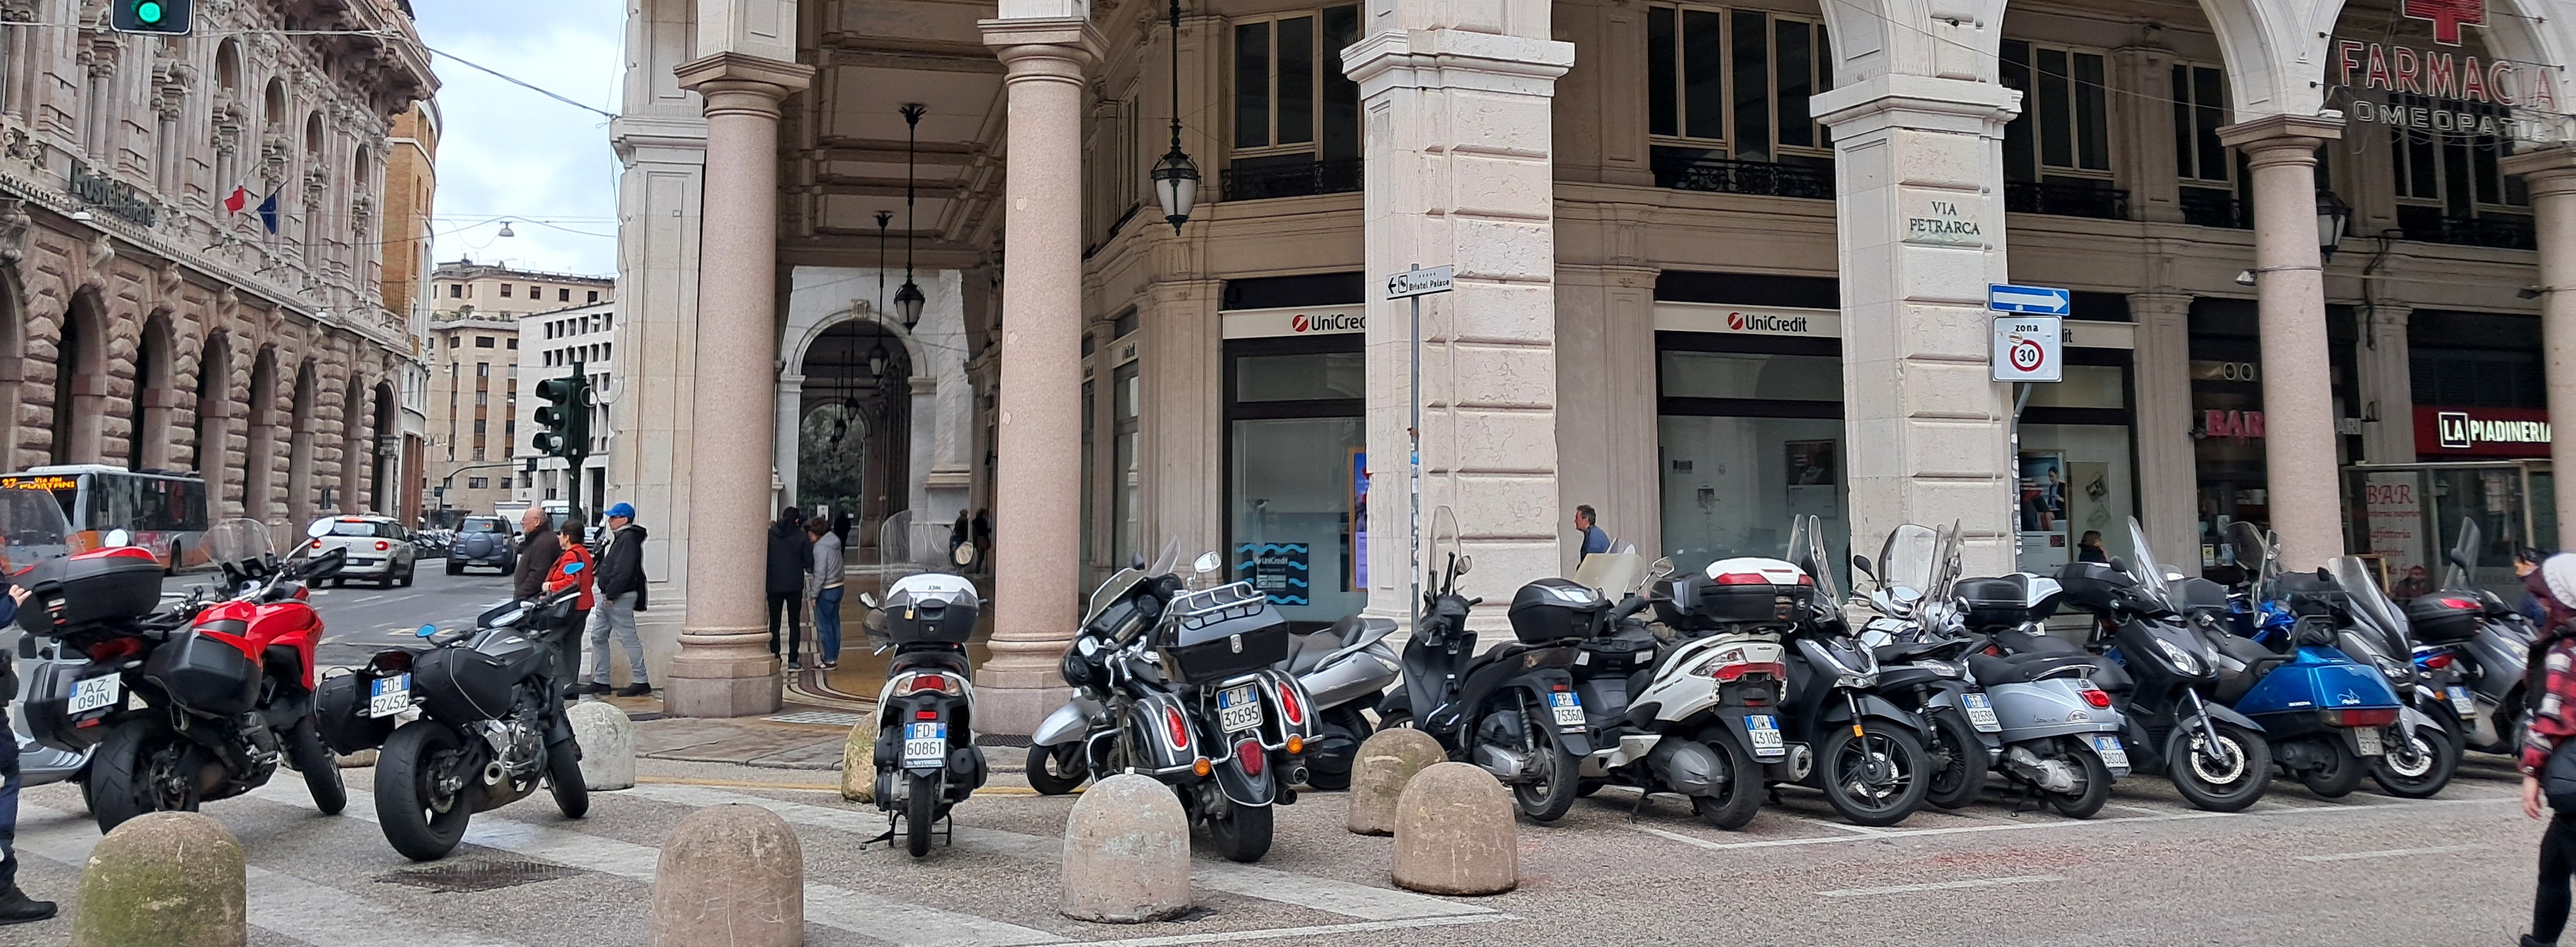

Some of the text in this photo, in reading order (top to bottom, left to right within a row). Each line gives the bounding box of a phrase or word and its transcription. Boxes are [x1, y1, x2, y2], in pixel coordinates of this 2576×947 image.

[2339, 40, 2557, 110] FARMACIA
[1931, 201, 1957, 215] VIA
[1909, 218, 1981, 235] PETRARCA
[1409, 279, 1450, 290] Bristol Palace
[1311, 314, 1365, 330] UniCre
[1746, 314, 1807, 332] UniCredit
[2019, 349, 2036, 362] 30
[2205, 409, 2265, 437] BAR
[2443, 419, 2466, 441] LA
[2366, 484, 2414, 504] BAR
[2370, 527, 2411, 543] affetteria
[83, 679, 107, 695] AZ
[381, 678, 395, 693] ED
[373, 694, 407, 714] 52452
[1228, 689, 1243, 705] CJ
[1556, 694, 1568, 706] EP
[1969, 696, 1978, 706] EF
[1224, 705, 1258, 727] 32695
[1555, 709, 1583, 722] 75360
[1753, 716, 1766, 728] DW
[1971, 710, 1995, 722] 92638
[915, 724, 931, 737] FD
[1755, 731, 1781, 744] 43105
[907, 741, 941, 755] 60861
[2101, 738, 2111, 749] CY
